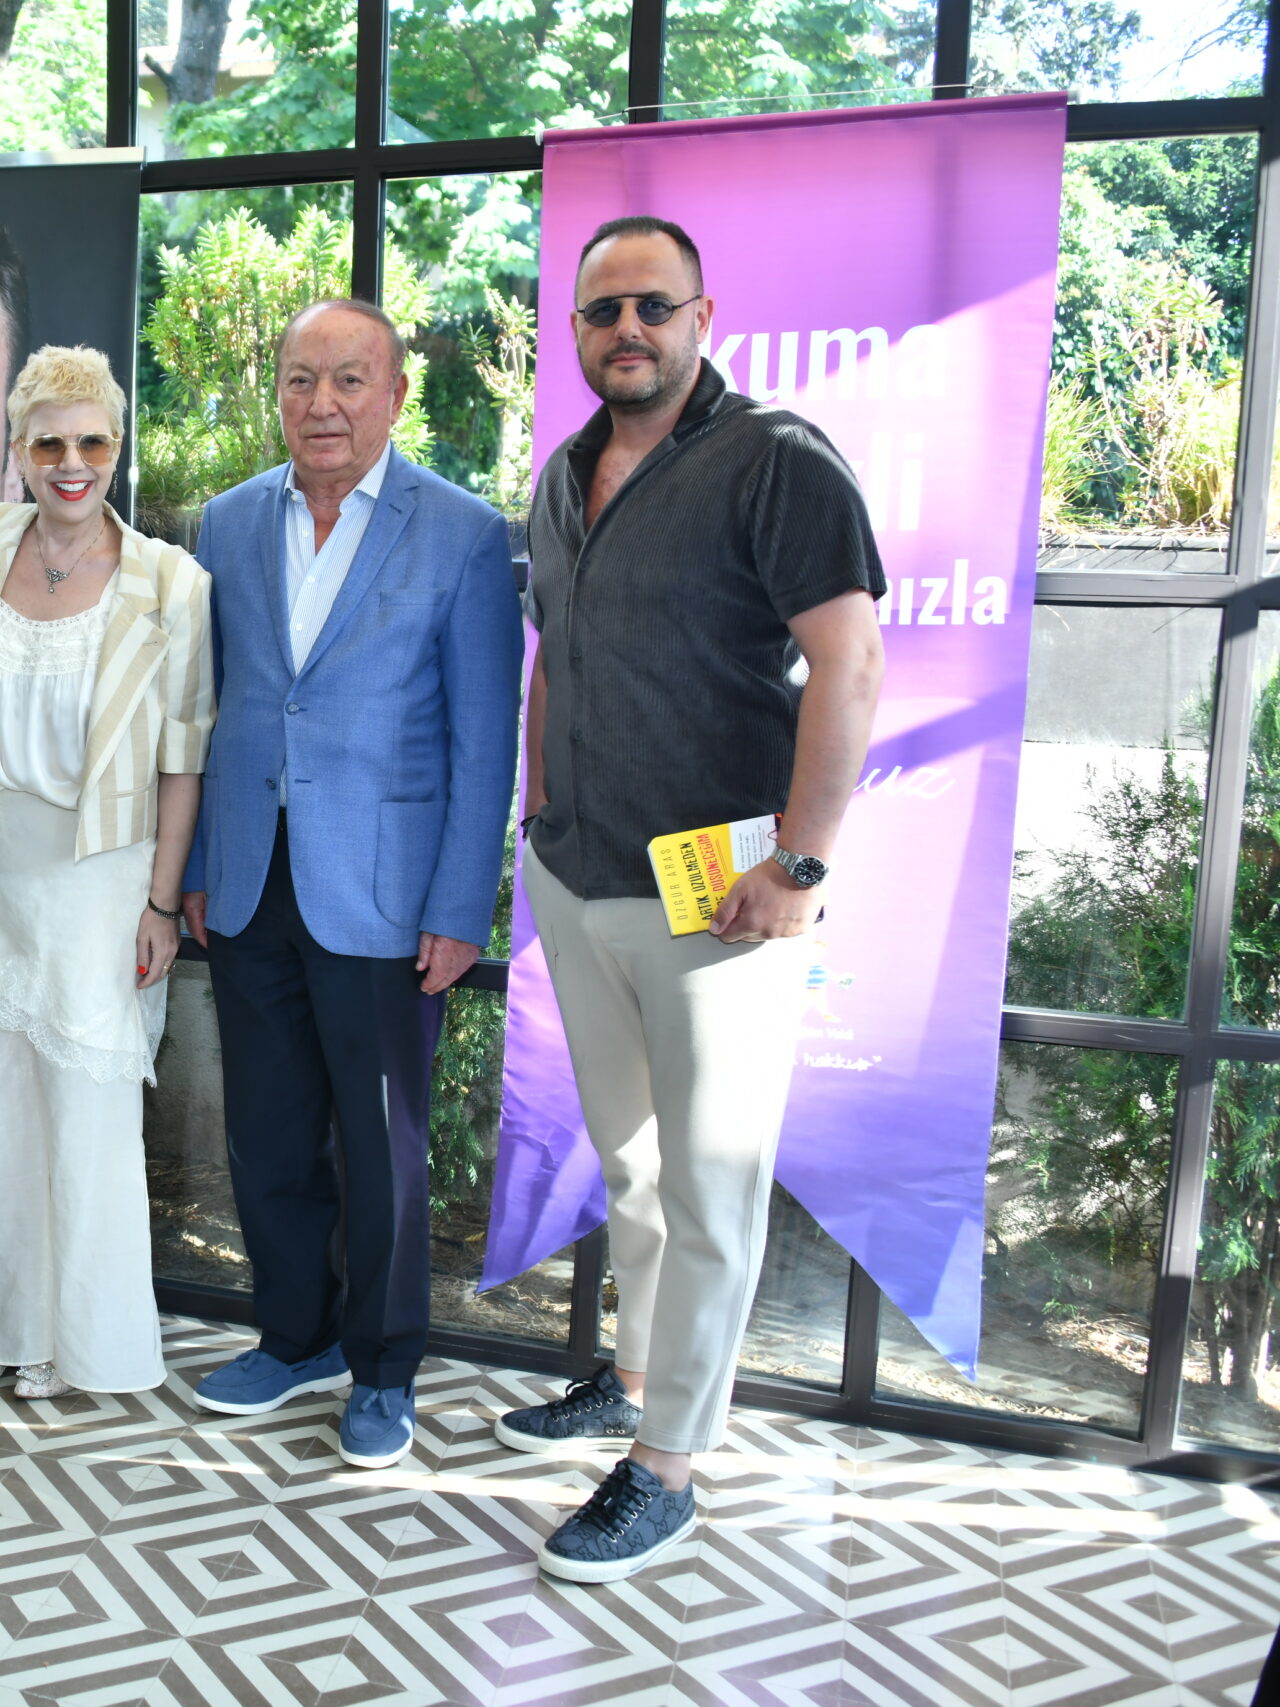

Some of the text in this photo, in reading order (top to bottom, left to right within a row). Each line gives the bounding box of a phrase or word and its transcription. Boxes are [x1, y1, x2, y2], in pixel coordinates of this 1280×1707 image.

[698, 317, 948, 404] kuma
[660, 848, 678, 877] ARAS
[680, 841, 715, 921] ARTIK ÜZÜLMEDEN
